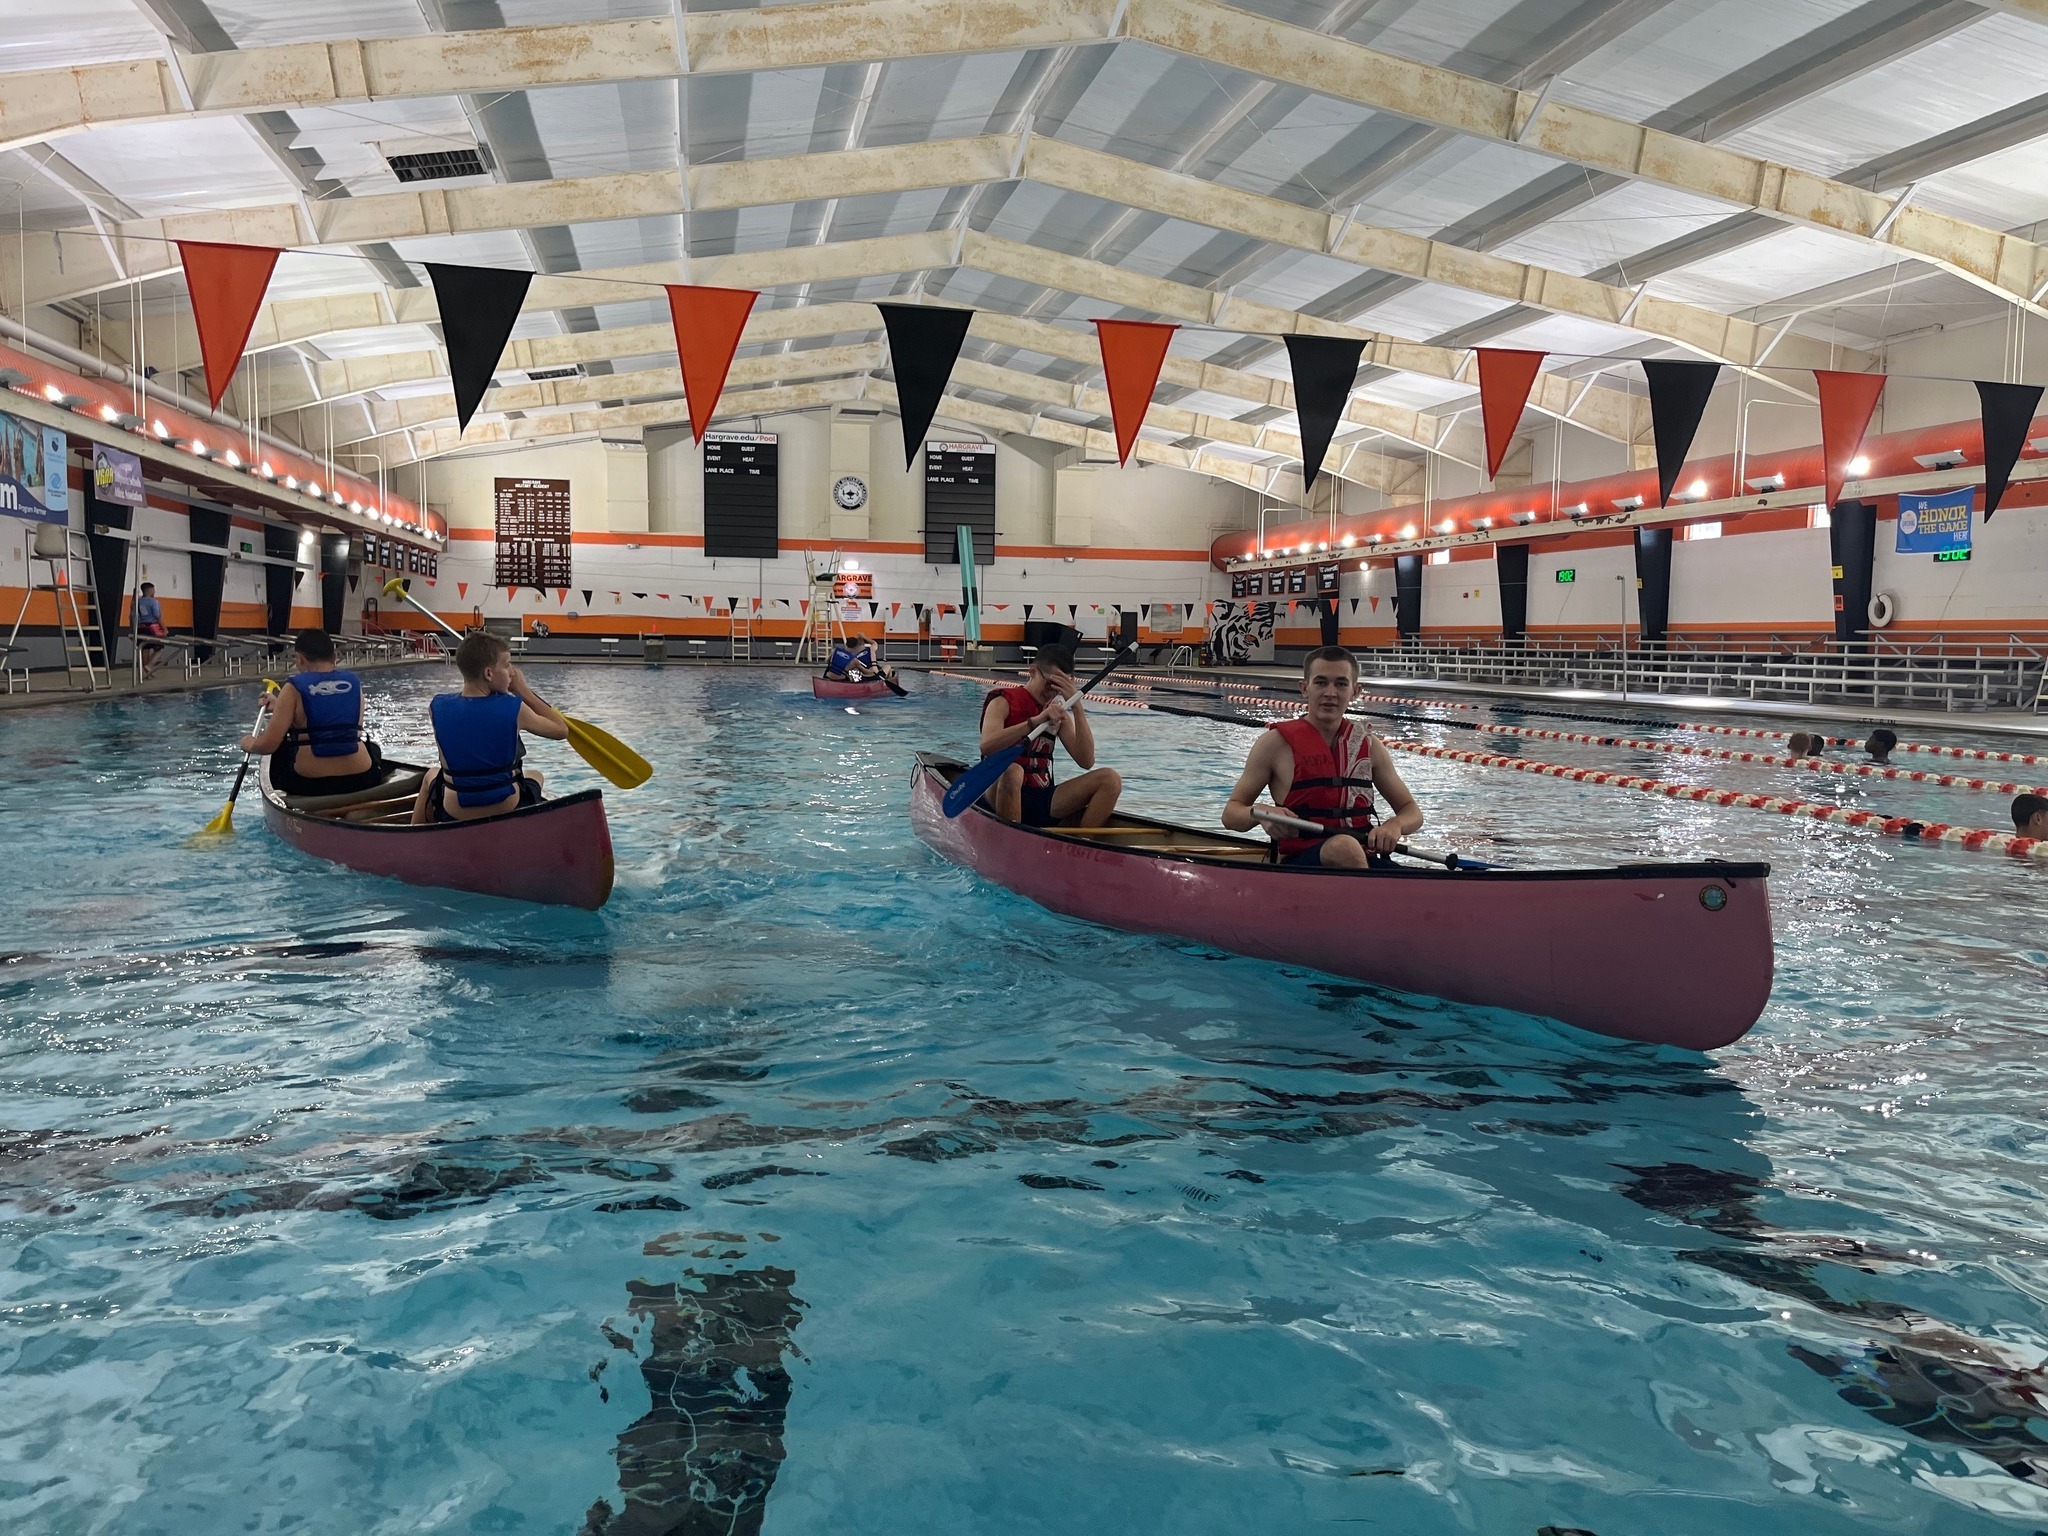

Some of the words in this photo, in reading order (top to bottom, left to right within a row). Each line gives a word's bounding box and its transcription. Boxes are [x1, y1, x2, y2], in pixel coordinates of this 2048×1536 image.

[705, 433, 776, 442] Hargrave.edu/Pool
[1918, 501, 1928, 510] WE
[1918, 505, 1968, 523] HONOR
[1917, 523, 1937, 535] THE
[1938, 520, 1968, 533] GAME
[836, 574, 872, 582] ARGRAVE
